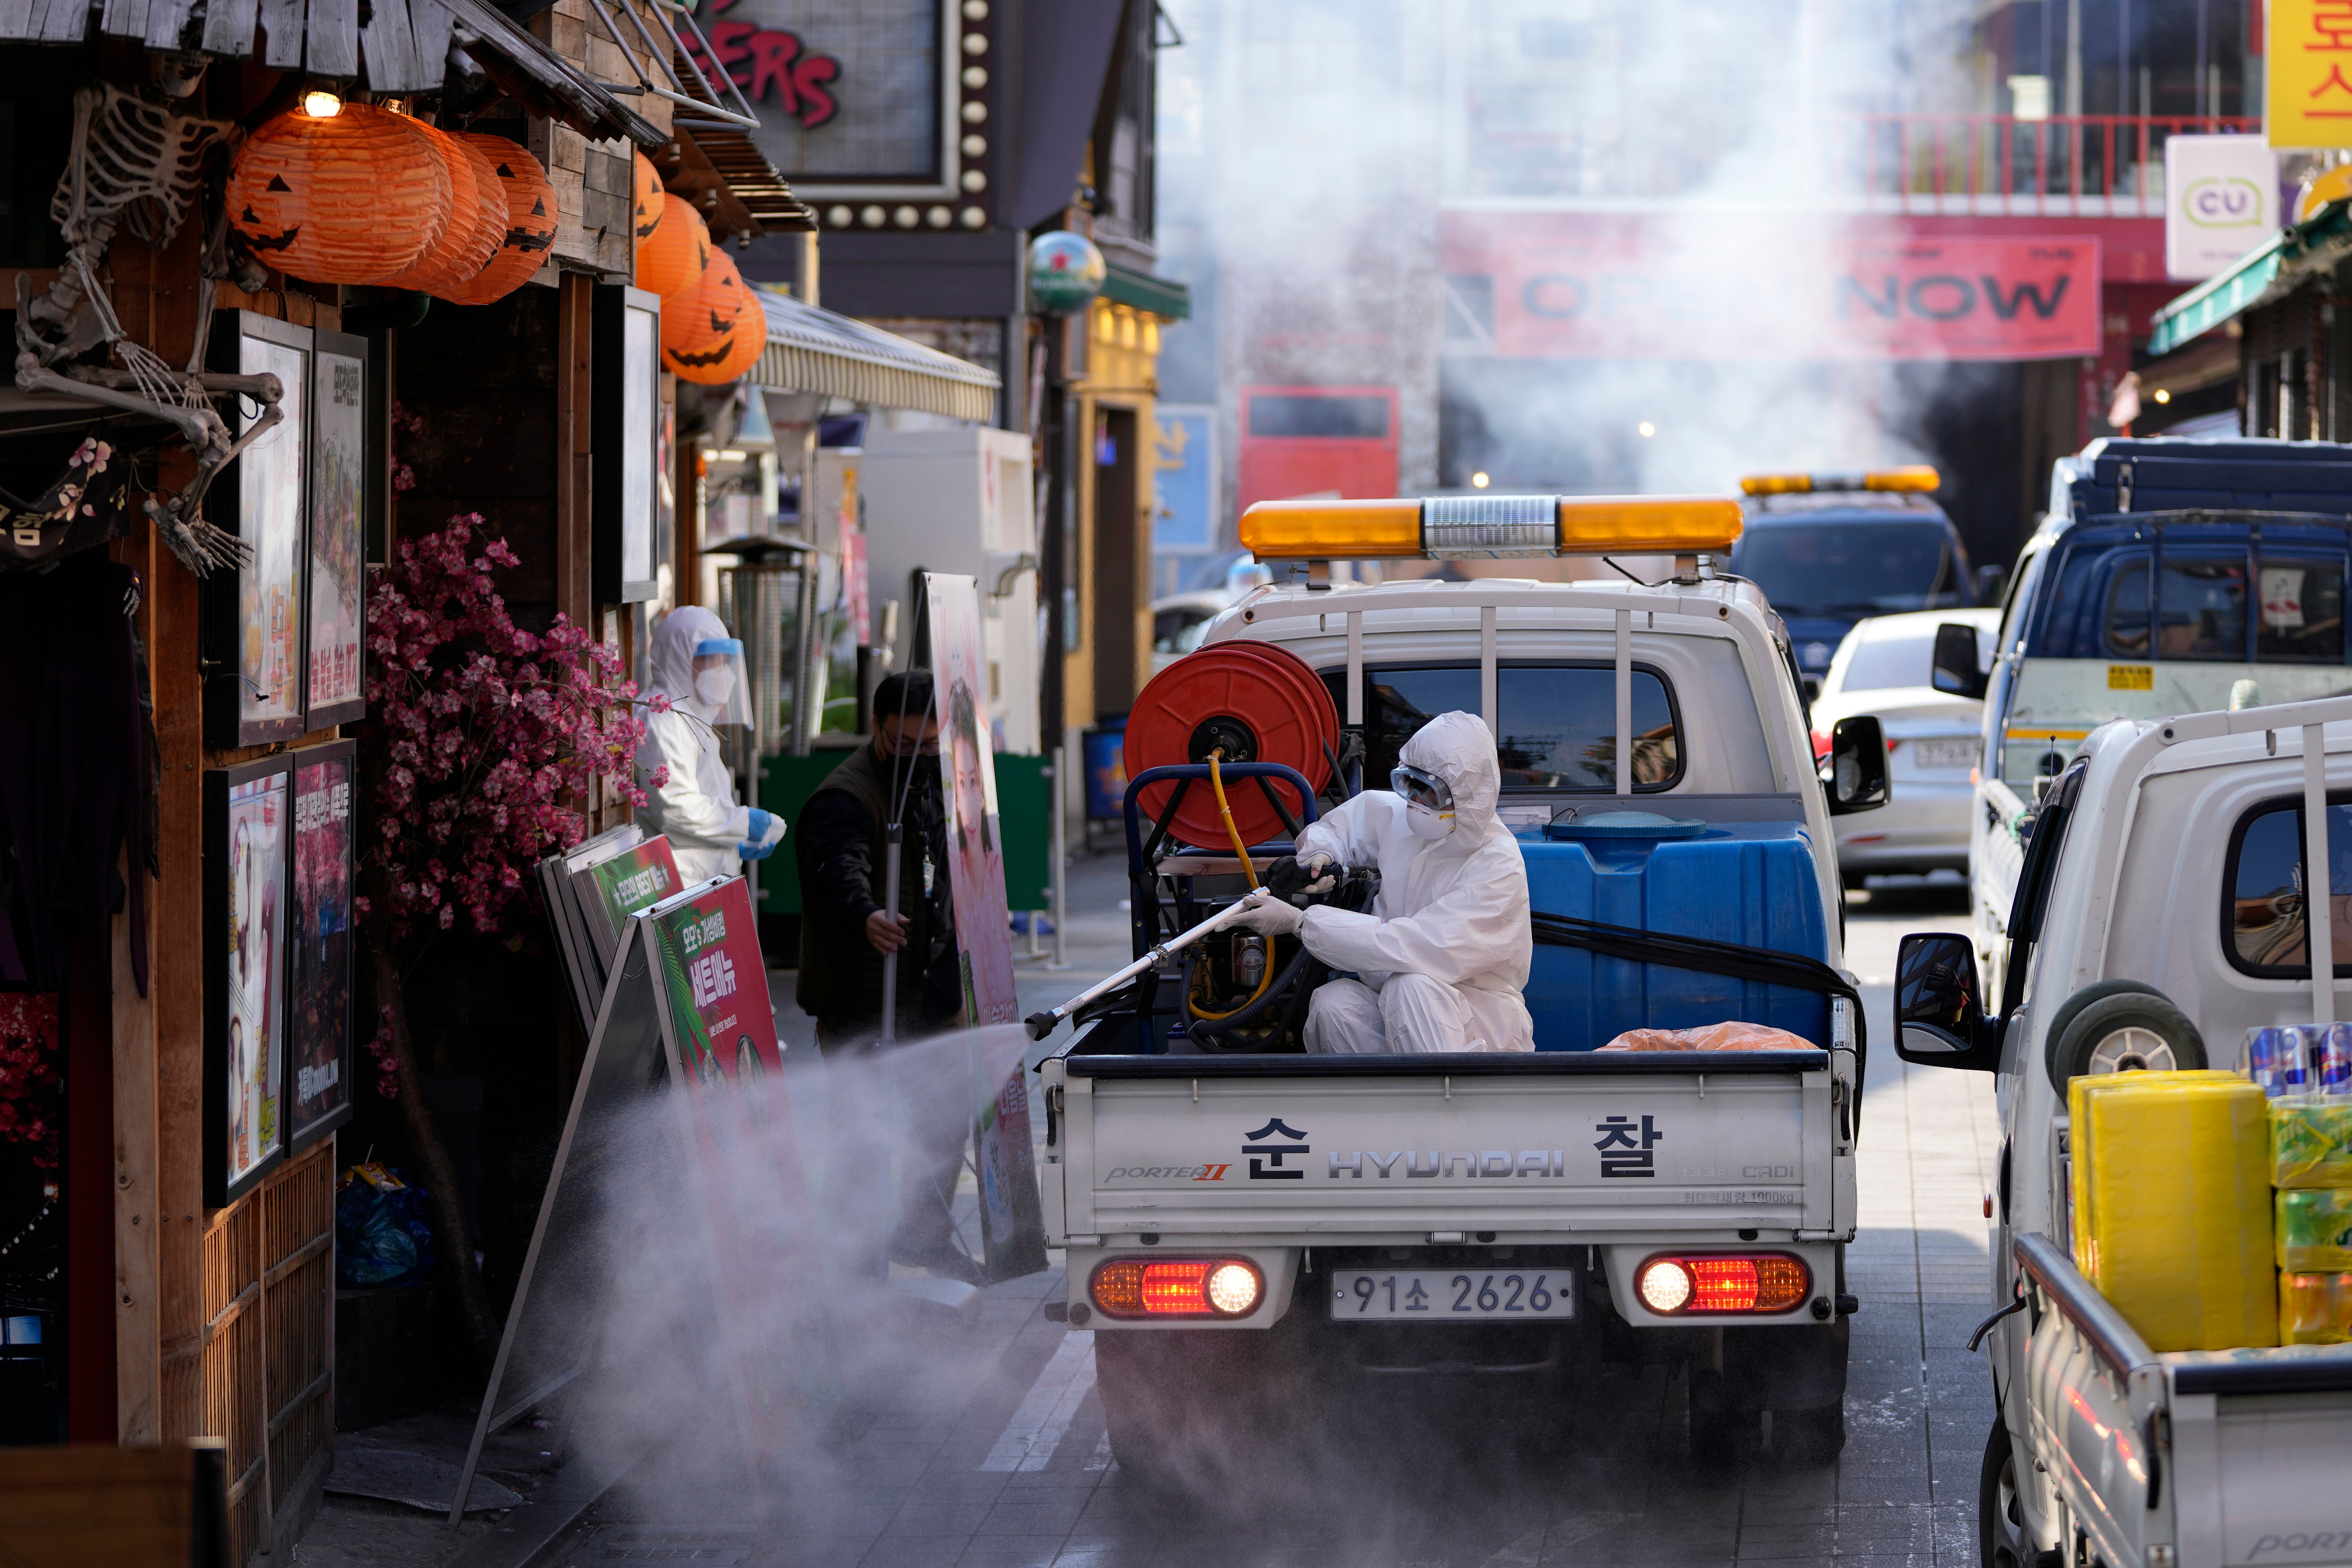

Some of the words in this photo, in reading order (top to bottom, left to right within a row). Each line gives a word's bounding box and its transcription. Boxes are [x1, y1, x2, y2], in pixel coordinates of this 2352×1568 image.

[2197, 191, 2247, 215] CU
[1836, 275, 2071, 320] NOW
[310, 649, 318, 704] 술
[618, 876, 641, 906] 모모의
[634, 870, 654, 897] BEST
[648, 865, 665, 891] 메뉴
[701, 910, 726, 947] 가성비킹
[690, 949, 737, 1009] 세트메뉴
[1241, 1118, 1310, 1179] 순
[1593, 1114, 1663, 1178] 찰
[1328, 1150, 1564, 1178] HYUNDAI
[1103, 1166, 1205, 1183] PORTER
[1742, 1165, 1794, 1178] CRDi
[1751, 1192, 1794, 1203] 1000kg
[1353, 1275, 1429, 1312] 91소
[1451, 1274, 1552, 1312] 2626
